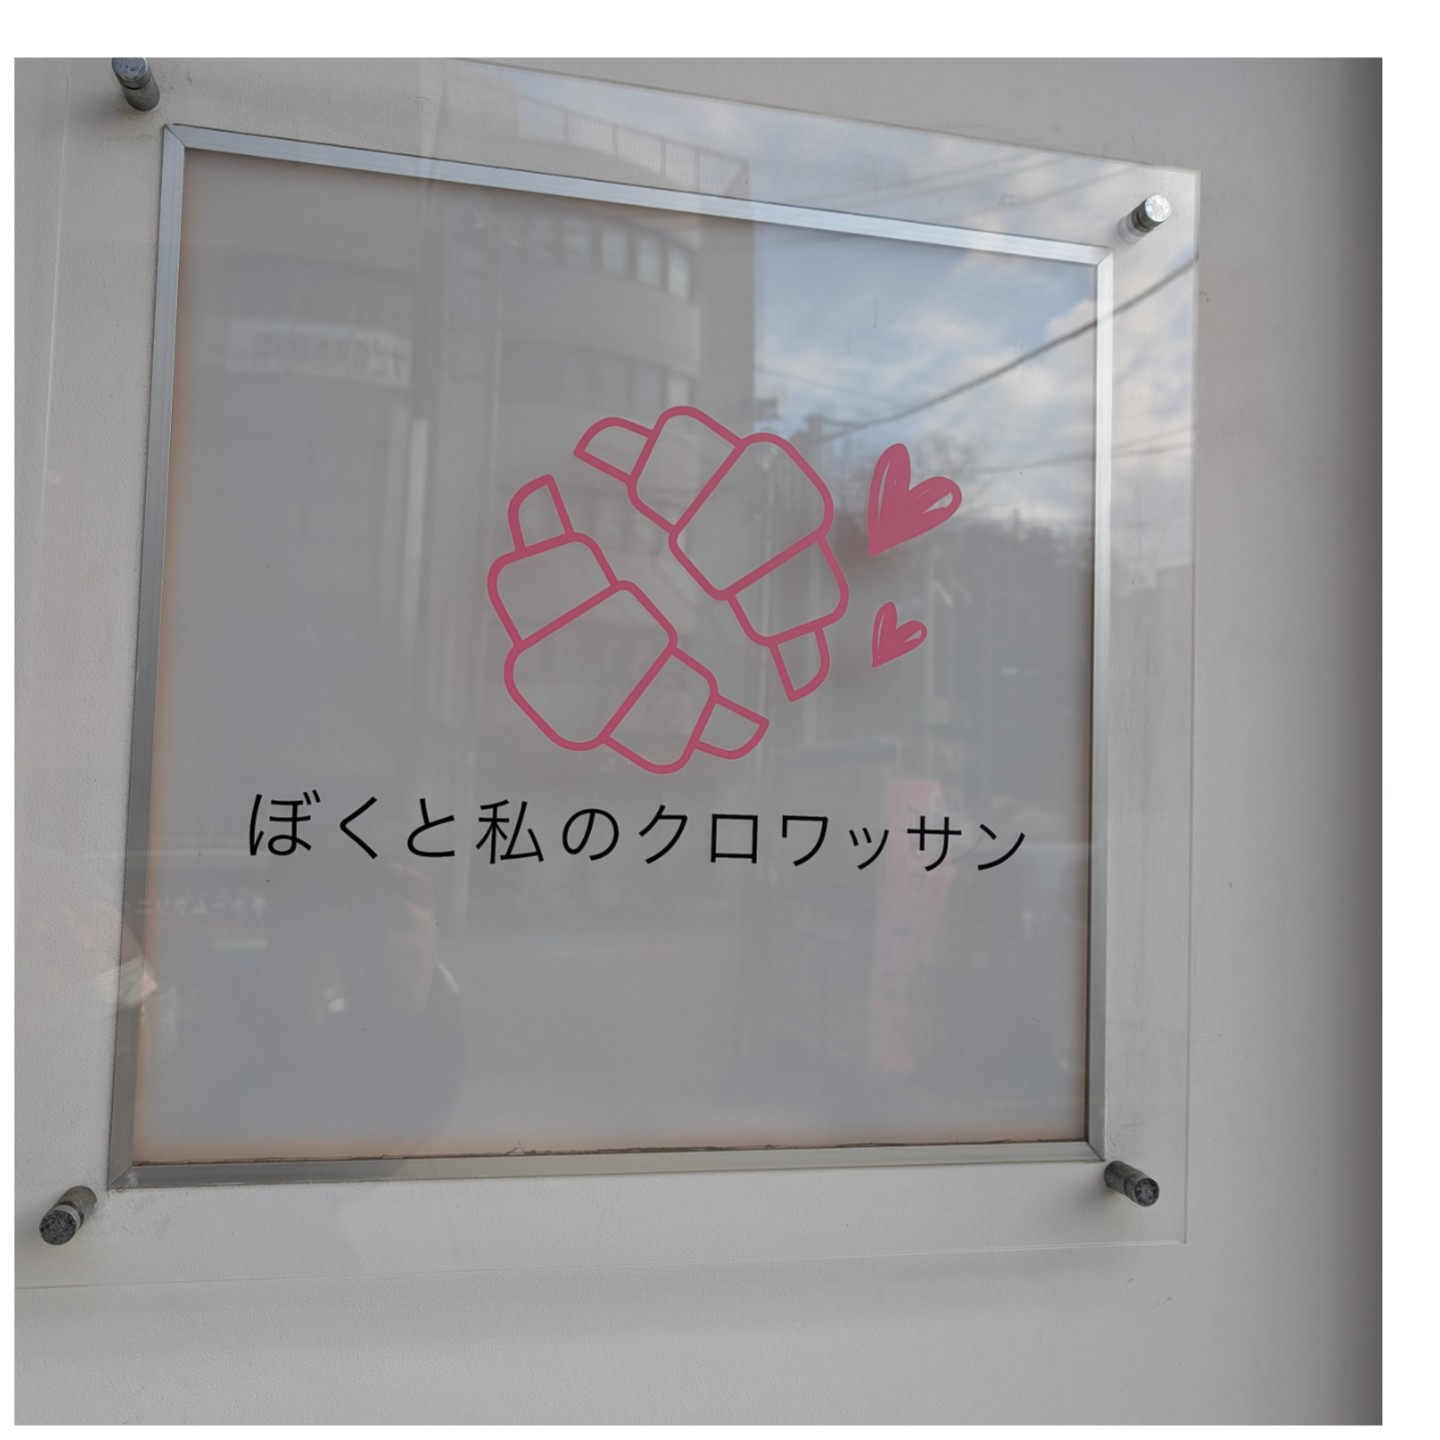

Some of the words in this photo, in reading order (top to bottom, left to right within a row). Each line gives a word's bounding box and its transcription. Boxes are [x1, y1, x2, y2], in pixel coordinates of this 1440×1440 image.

[247, 788, 1027, 873] ぼくと私のクロワッサン
